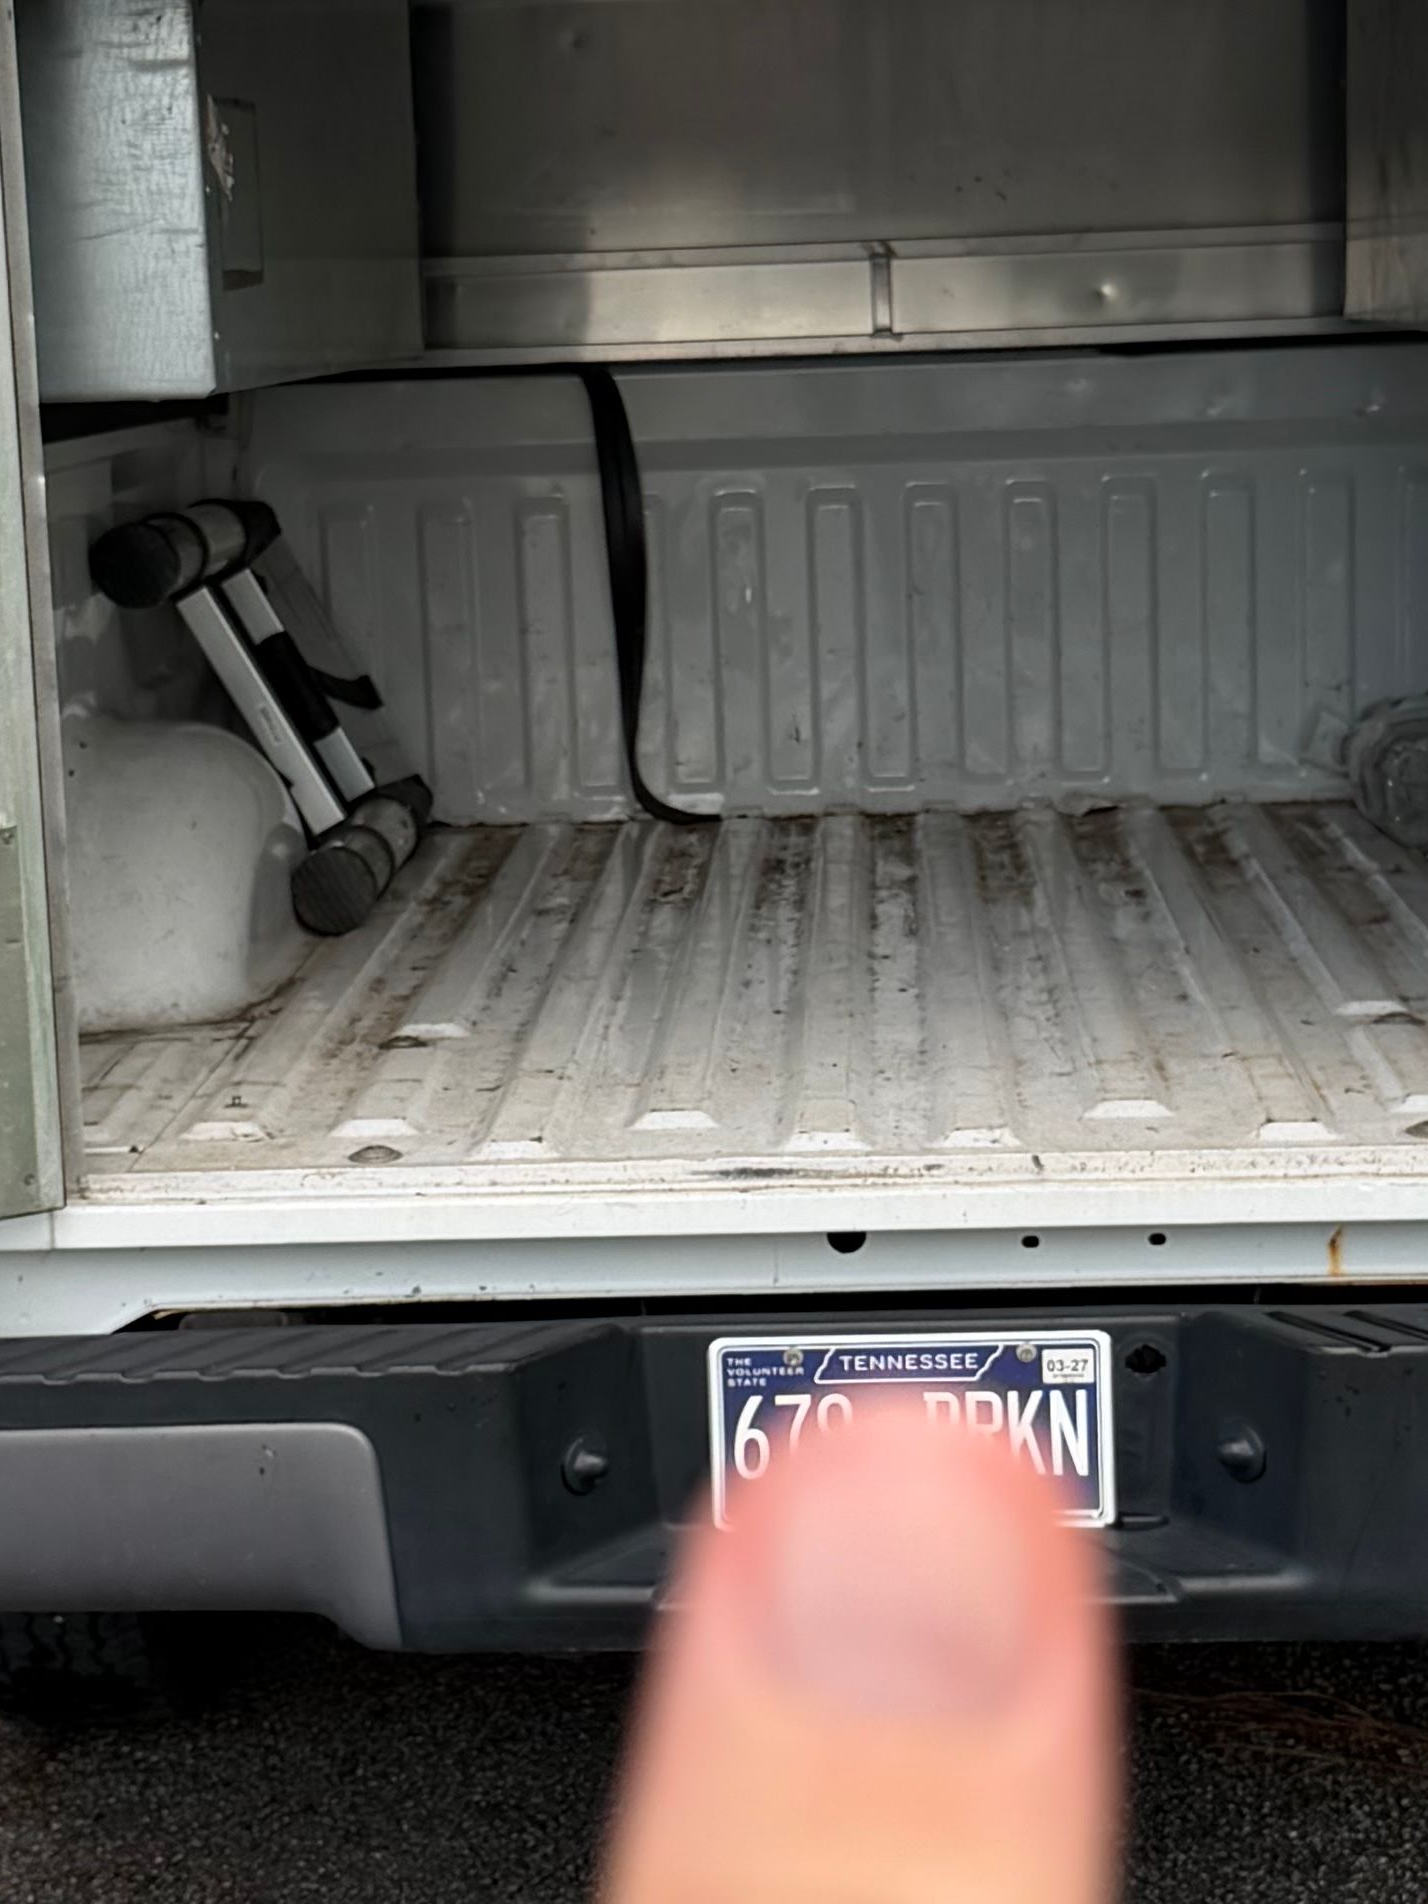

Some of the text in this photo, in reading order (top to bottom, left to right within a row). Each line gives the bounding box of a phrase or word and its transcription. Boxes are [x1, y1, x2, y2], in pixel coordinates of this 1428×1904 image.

[726, 1357, 752, 1367] THE
[838, 1352, 979, 1372] TENNESSEE
[1046, 1358, 1089, 1372] 03-27
[726, 1366, 805, 1377] VOLUNTEER
[726, 1377, 768, 1388] STATE
